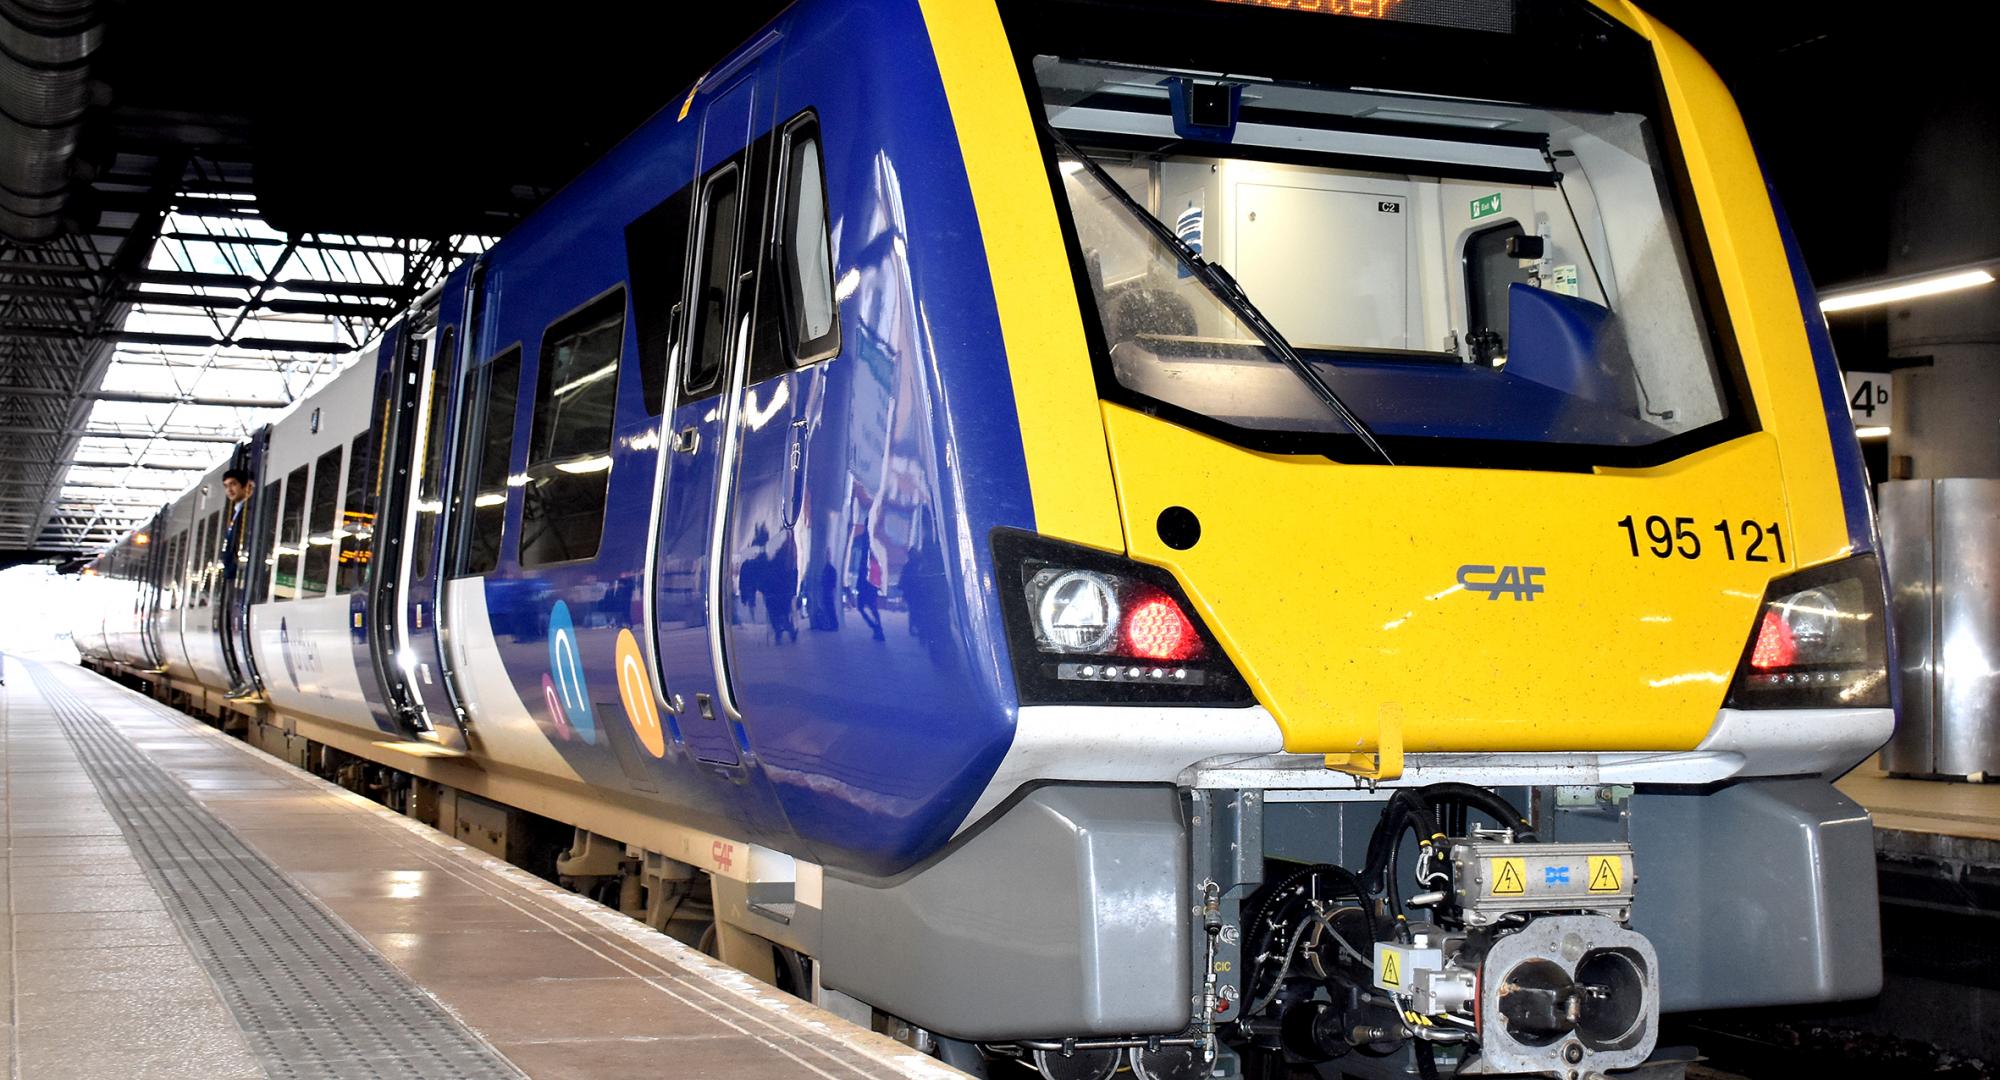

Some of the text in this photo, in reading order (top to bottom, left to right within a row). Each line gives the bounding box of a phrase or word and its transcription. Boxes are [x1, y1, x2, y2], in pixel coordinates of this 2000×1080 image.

[1382, 202, 1395, 212] C2
[1618, 515, 1787, 563] 195 121
[1456, 564, 1546, 601] CAF
[712, 841, 733, 872] CAF
